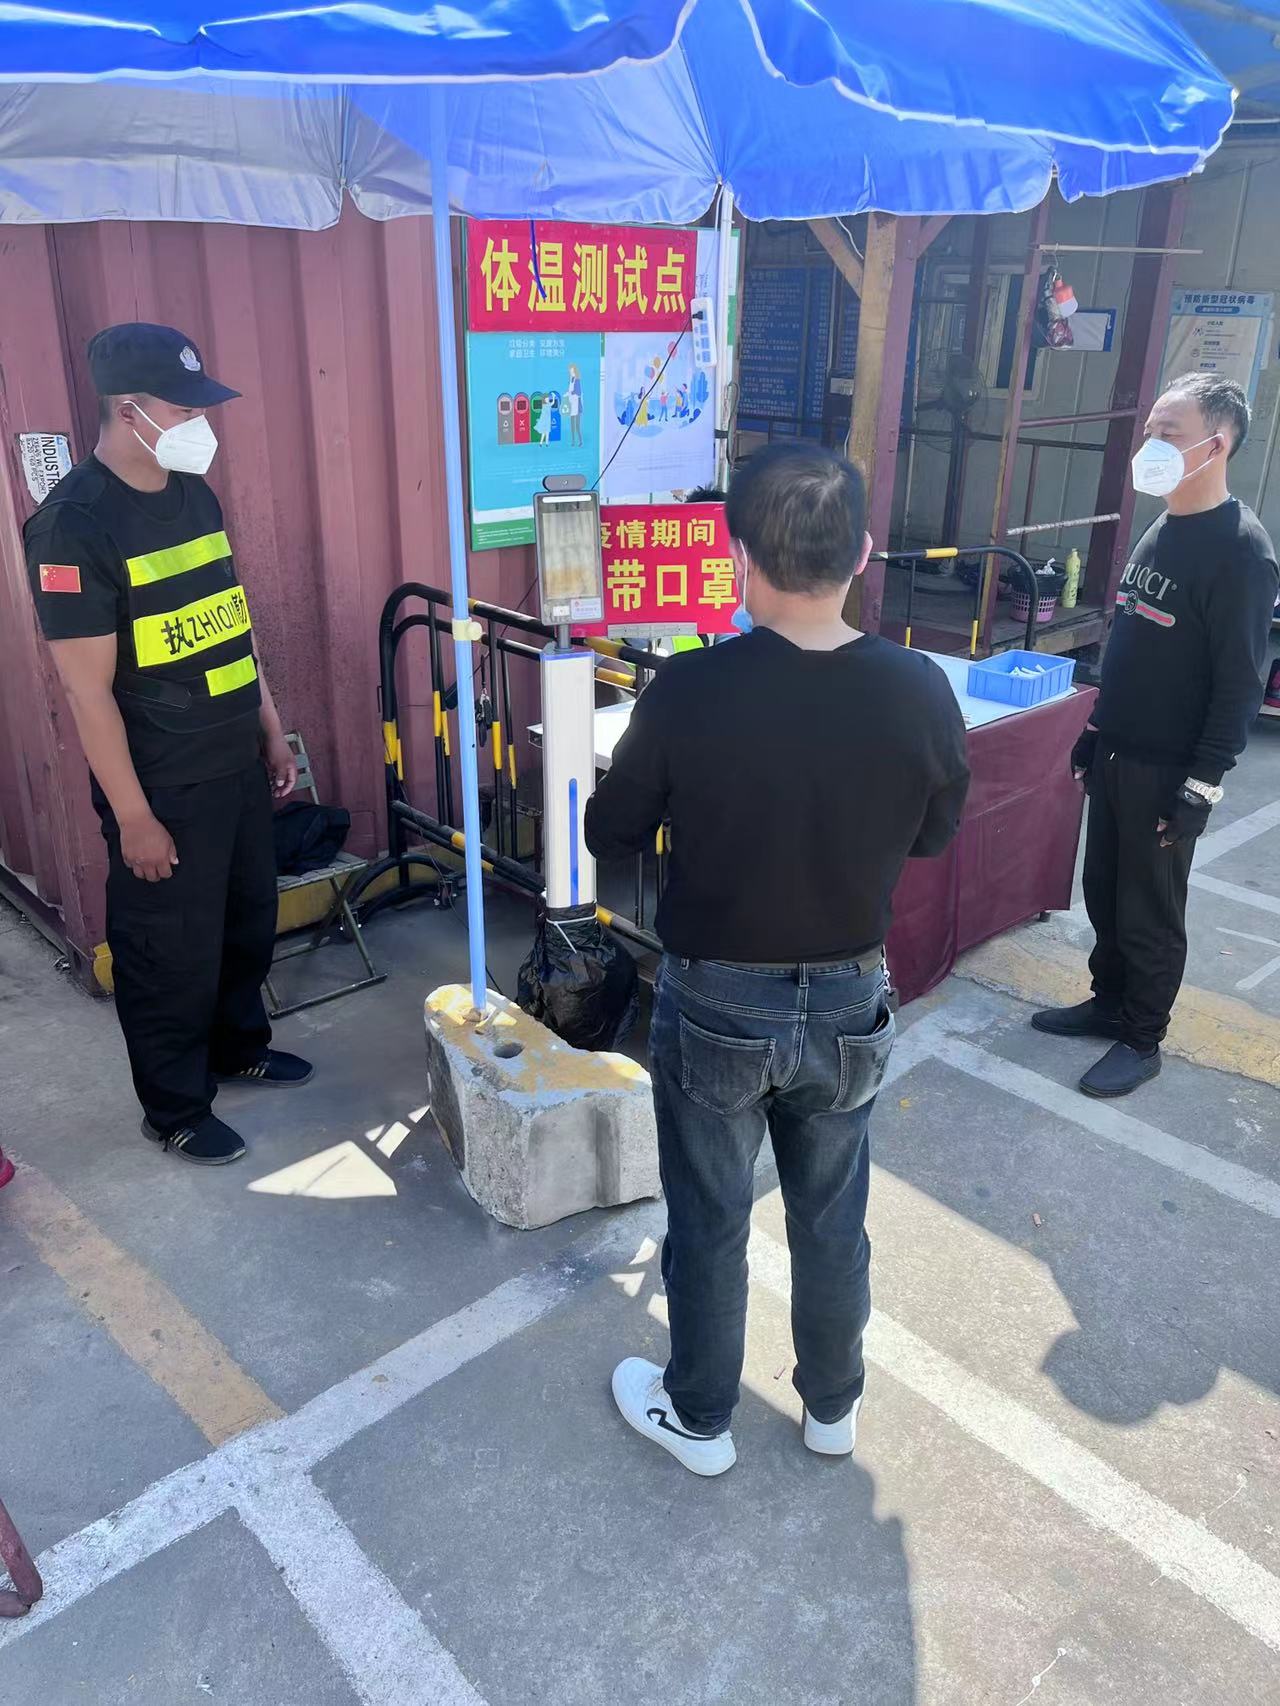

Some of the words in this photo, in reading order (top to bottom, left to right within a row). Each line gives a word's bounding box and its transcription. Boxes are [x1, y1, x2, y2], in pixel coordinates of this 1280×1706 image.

[480, 237, 687, 314] 体温测试点
[41, 436, 60, 490] INDUSTR
[607, 558, 737, 612] 带口罩
